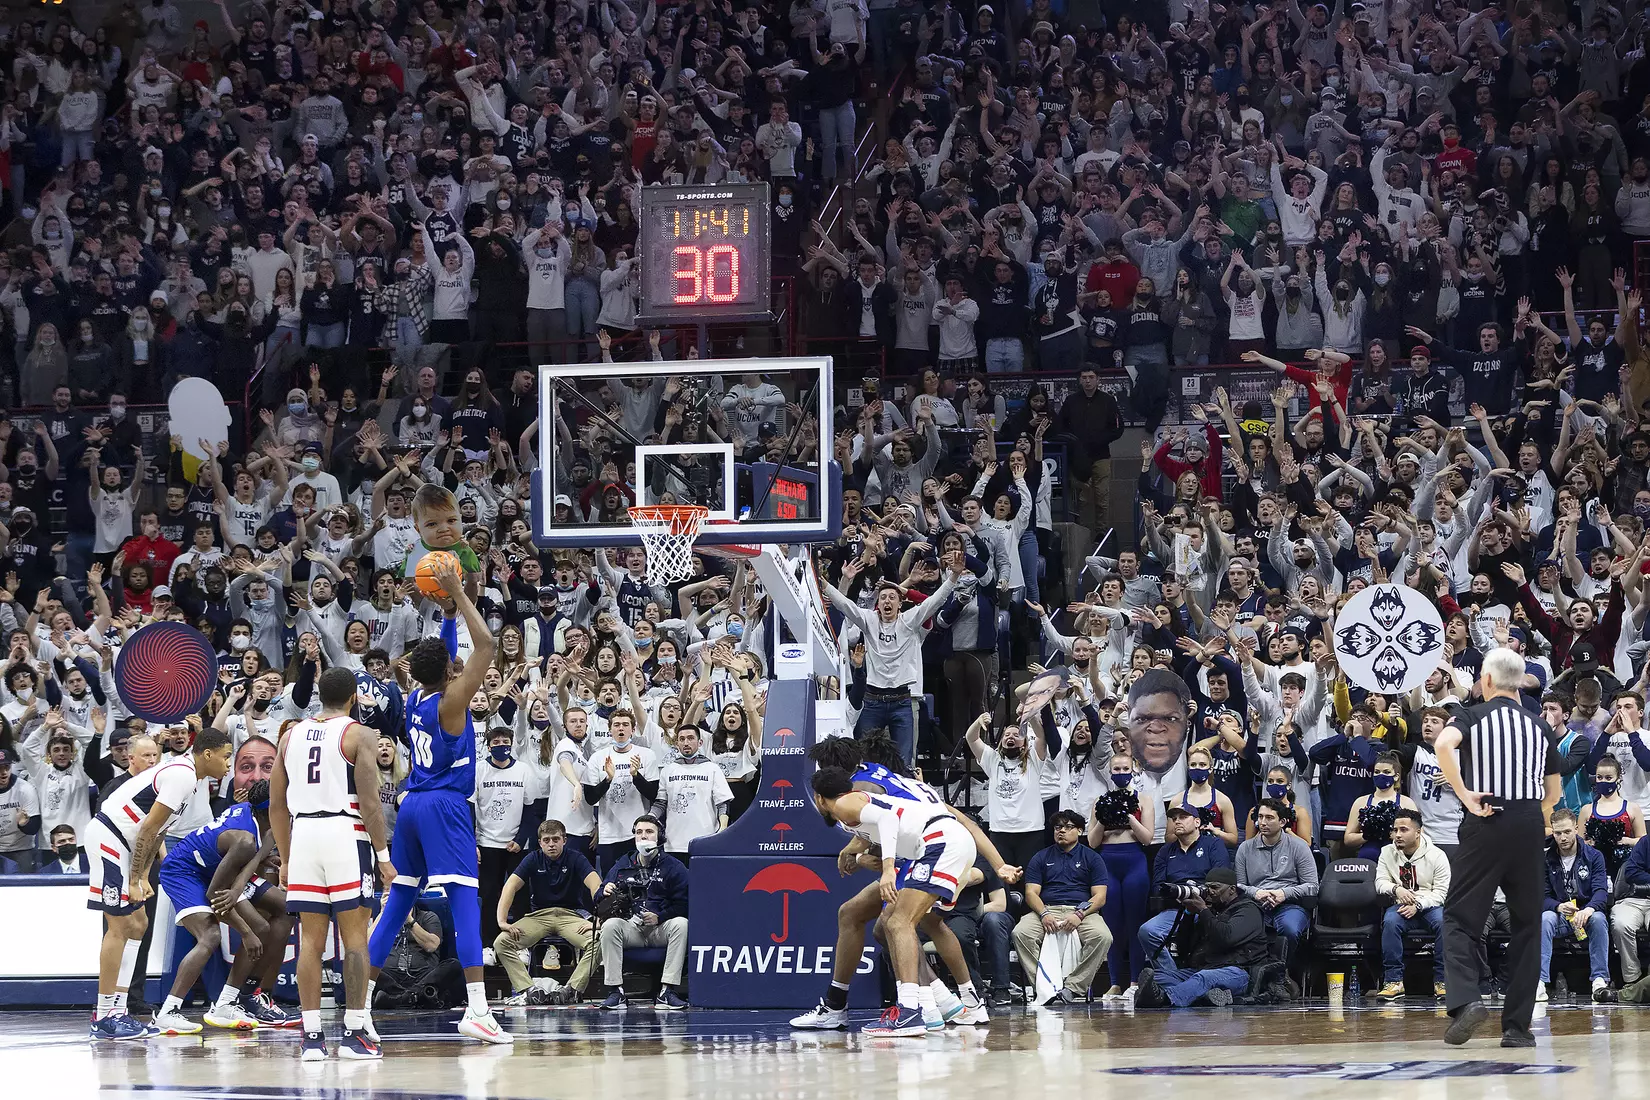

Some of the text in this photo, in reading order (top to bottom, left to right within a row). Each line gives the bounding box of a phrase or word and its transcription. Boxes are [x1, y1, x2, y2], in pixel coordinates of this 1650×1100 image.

[1184, 76, 1195, 90] 15
[518, 146, 527, 160] 2
[389, 191, 404, 204] 34
[675, 192, 734, 200] TS-SPORTS.COM
[674, 207, 749, 237] 11:41
[434, 229, 446, 243] 32
[673, 244, 741, 304] 30
[1463, 290, 1485, 298] UCONN
[363, 302, 373, 314] 3
[1130, 312, 1159, 326] UCONN
[1473, 359, 1501, 373] UCONN
[1186, 377, 1196, 388] 23
[1247, 422, 1268, 434] CSC
[235, 510, 263, 521] UCONN
[244, 519, 255, 537] 15
[621, 592, 654, 606] UCONN
[628, 607, 643, 627] 15
[1582, 651, 1590, 663] B
[219, 663, 241, 673] UCO
[306, 729, 326, 742] COLE
[408, 725, 433, 767] 10
[760, 747, 806, 757] TRAVELERS
[307, 746, 322, 785] 2
[1335, 765, 1372, 778] UCONN
[483, 780, 525, 789] BEAT SETON HALL
[668, 775, 681, 783] BEAT
[696, 775, 709, 783] HALL
[1421, 779, 1443, 803] 34
[758, 842, 805, 851] TRAVELERS
[1333, 864, 1370, 873] UCONN
[690, 945, 876, 975] TRAVELES
